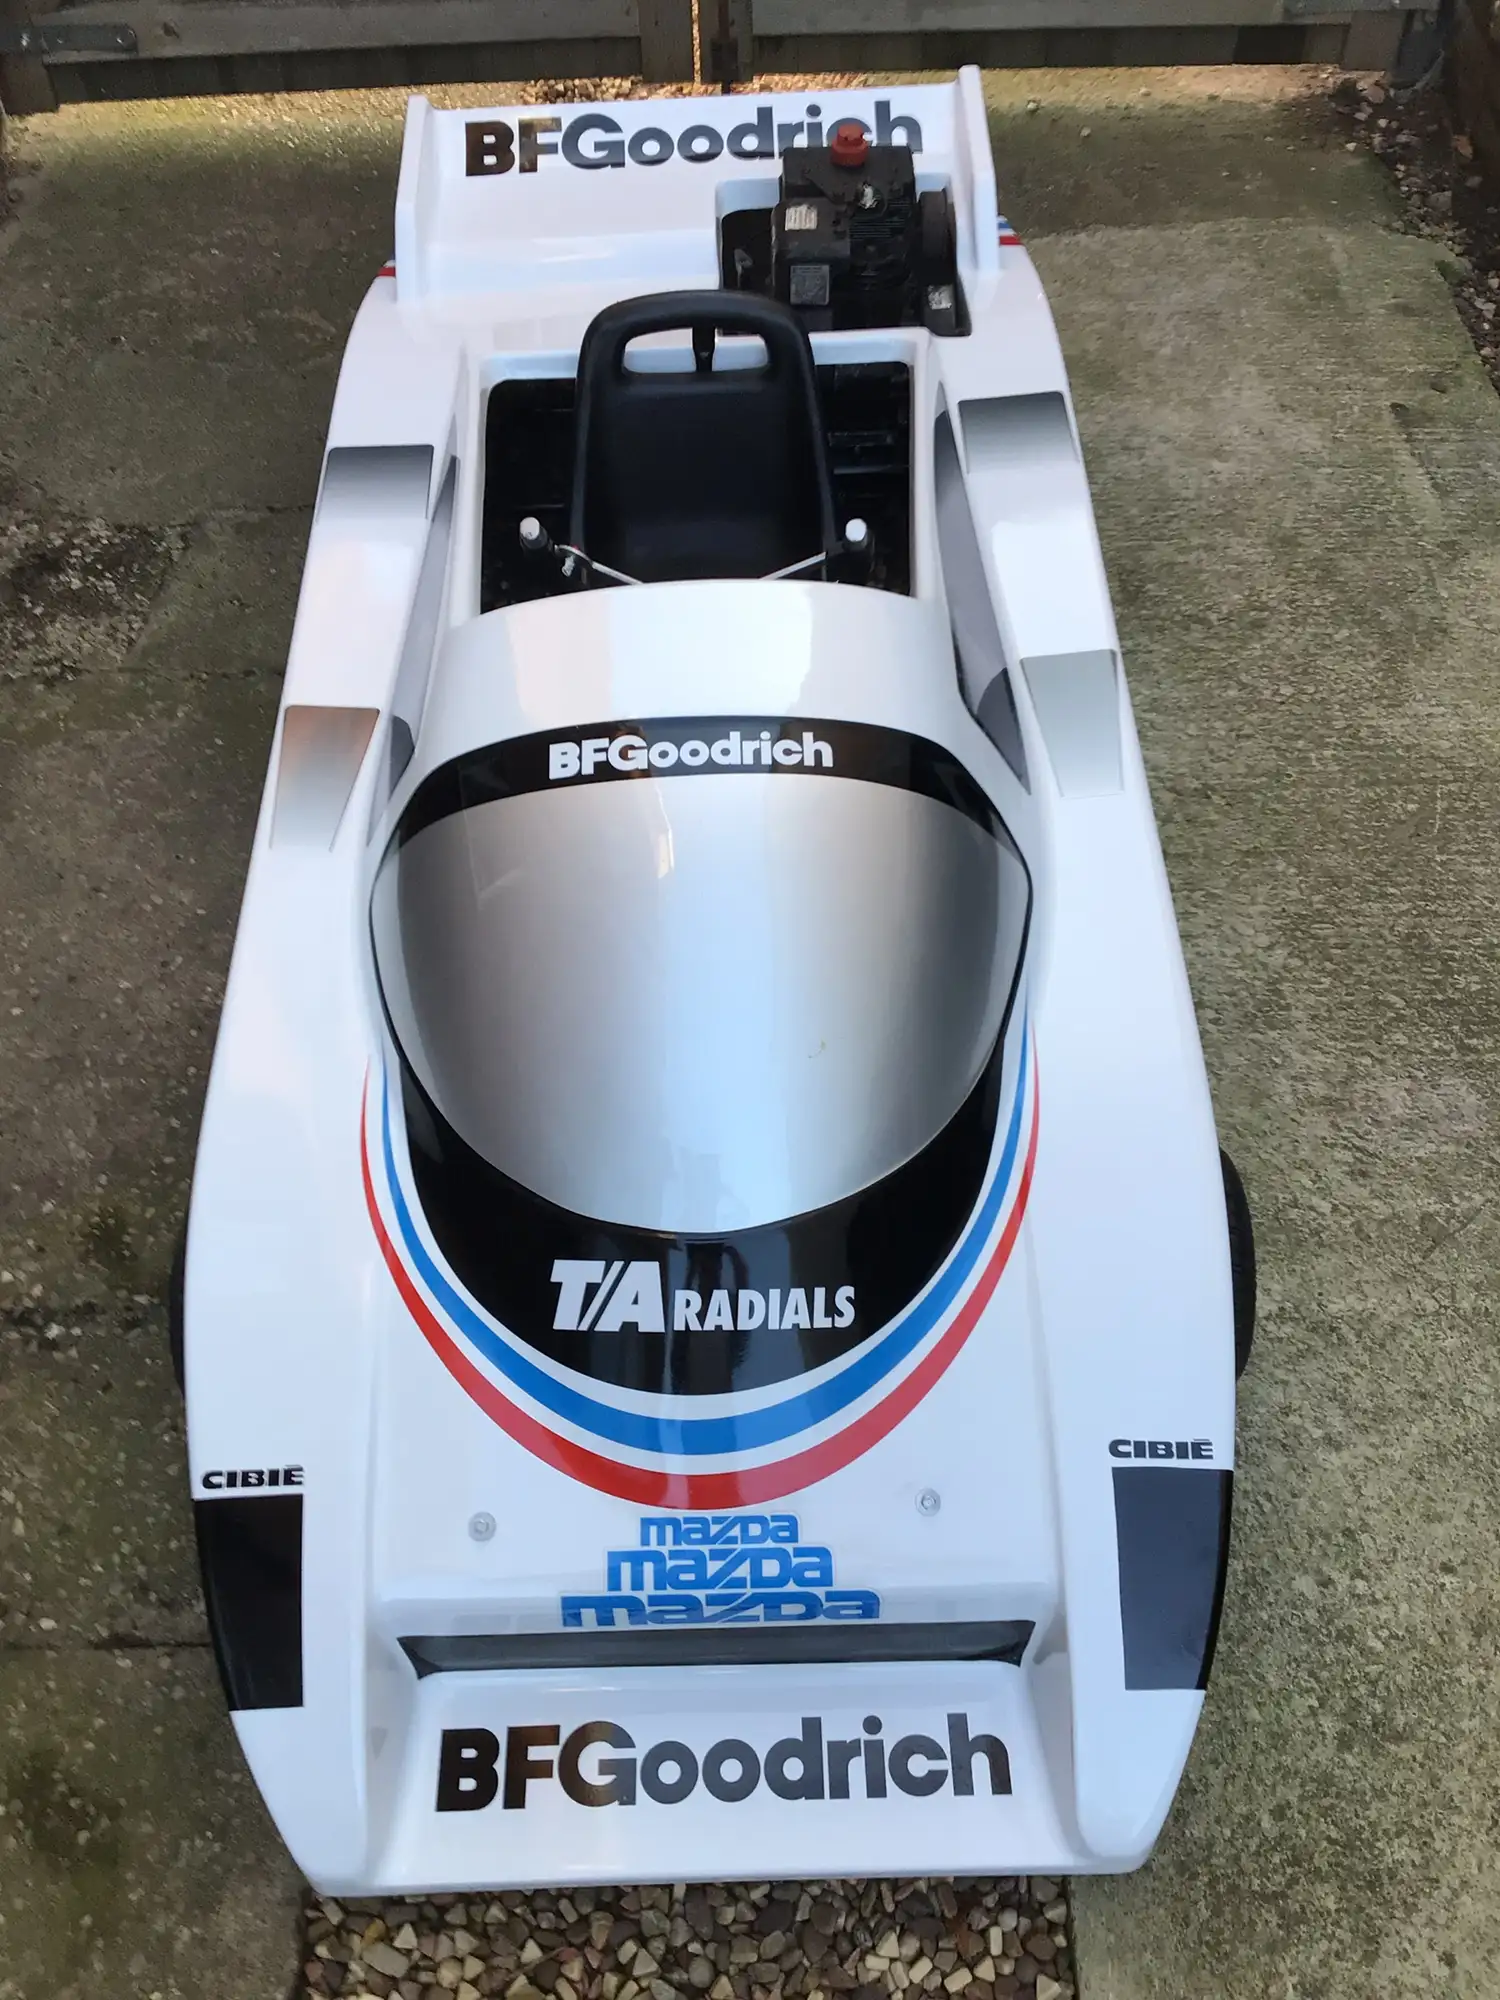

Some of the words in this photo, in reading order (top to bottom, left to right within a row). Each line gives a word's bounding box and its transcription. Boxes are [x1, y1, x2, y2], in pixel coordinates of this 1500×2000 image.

[549, 731, 834, 780] BFGoodrich
[550, 1259, 666, 1333] T/A
[673, 1285, 856, 1332] RADIALS
[640, 1513, 799, 1546] mazda
[607, 1546, 833, 1592] mazda
[560, 1589, 881, 1628] mazda
[436, 1712, 1013, 1812] BFGoodrich
